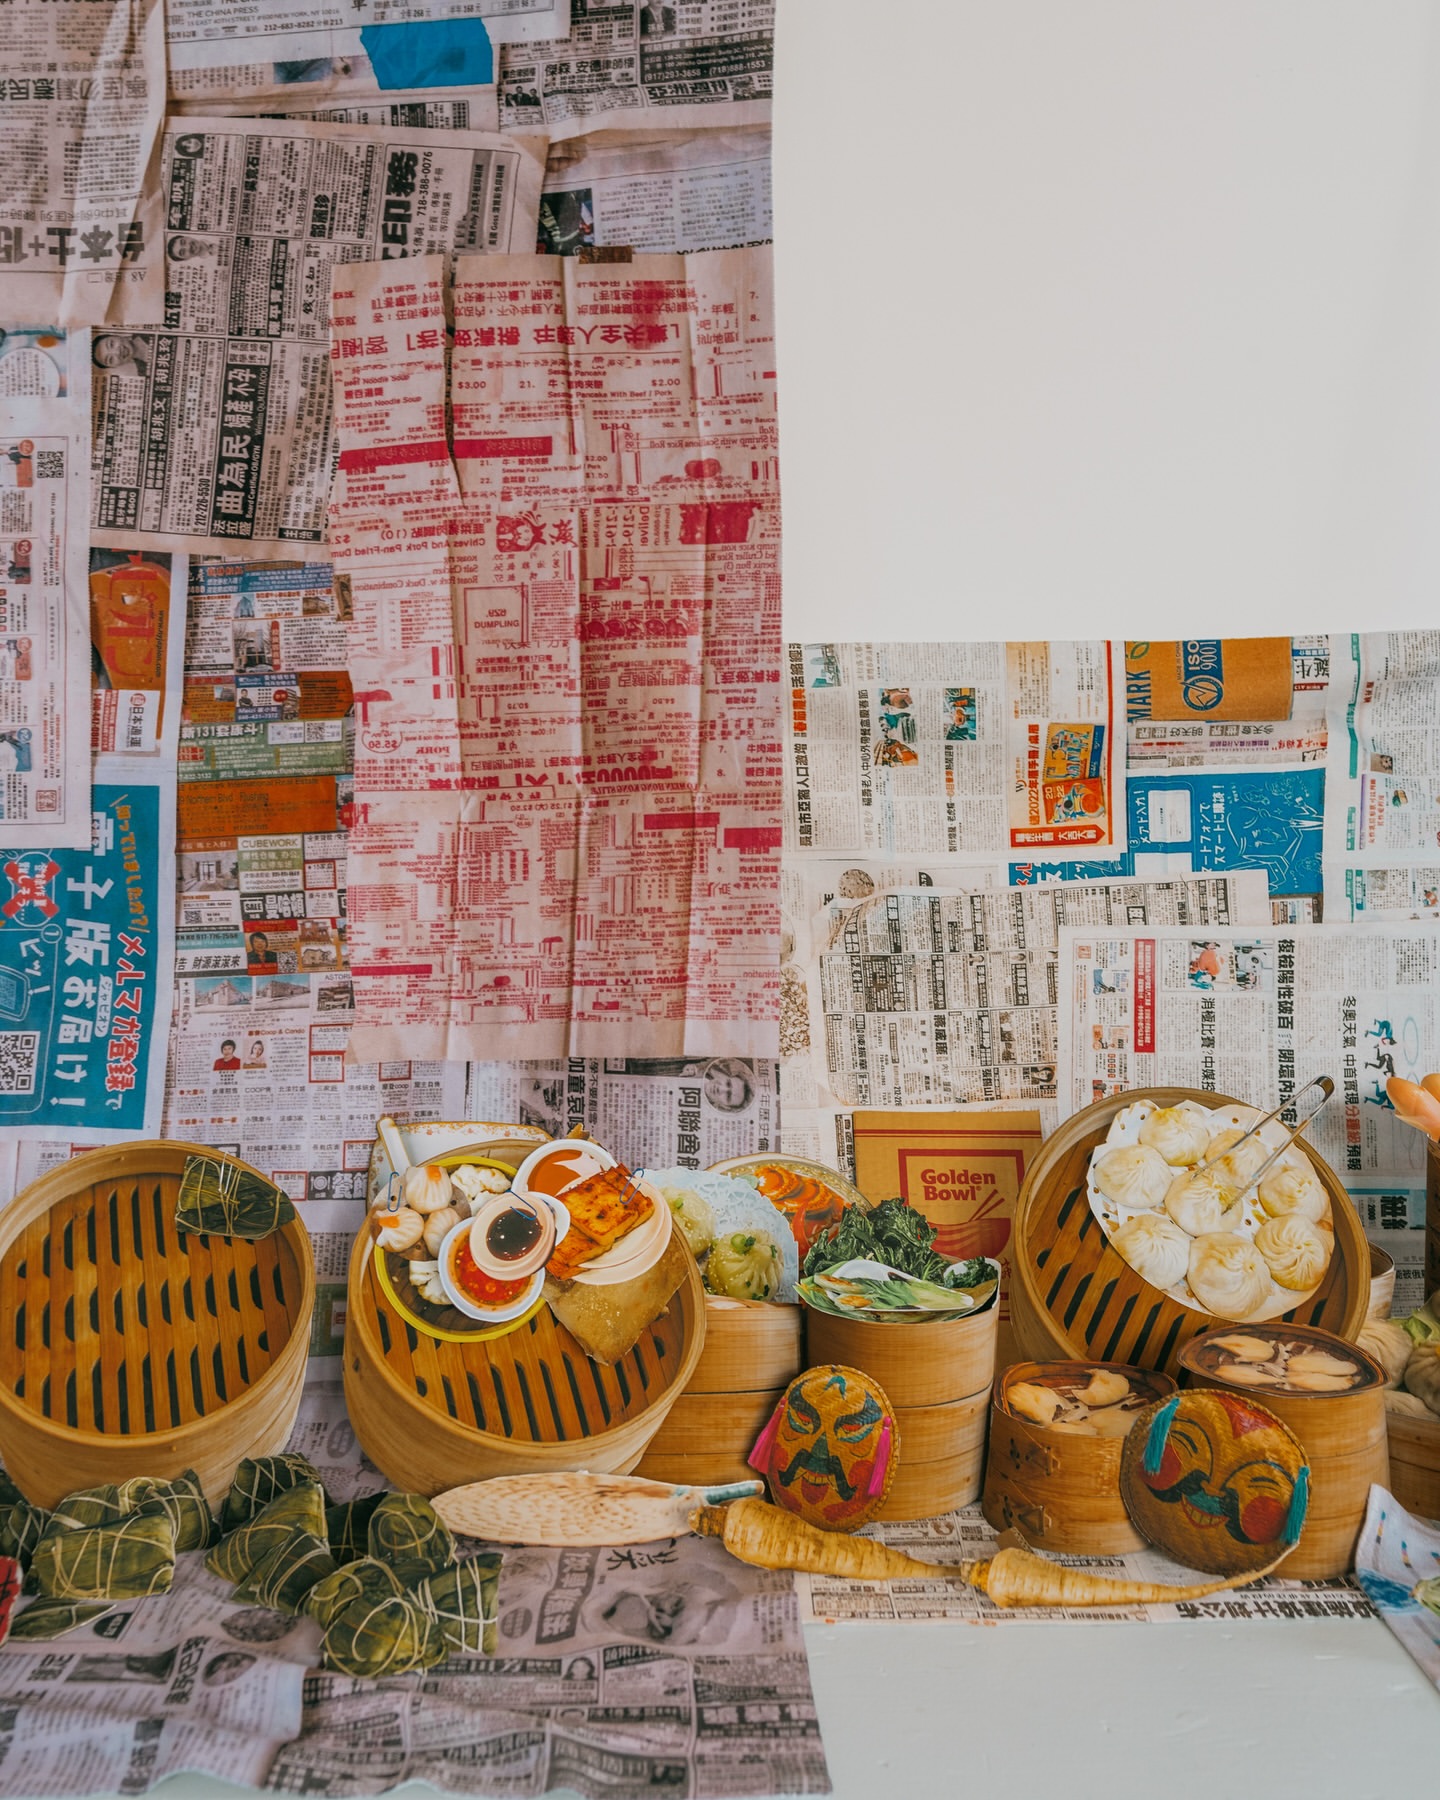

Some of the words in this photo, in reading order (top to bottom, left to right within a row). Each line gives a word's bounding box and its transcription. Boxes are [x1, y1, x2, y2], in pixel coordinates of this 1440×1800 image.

[205, 9, 230, 17] CHINA
[234, 6, 258, 14] PRESS
[416, 150, 433, 216] 718-388-0076
[130, 271, 146, 280] A8
[225, 366, 257, 396] 不孕
[457, 380, 486, 389] $3.00
[519, 380, 535, 388] 21.
[651, 378, 681, 387] $2.00
[610, 390, 621, 398] With
[654, 389, 672, 397] Pork
[223, 398, 254, 429] 婦產
[247, 471, 257, 499] Certified
[194, 477, 211, 526] 212-226-5530
[211, 518, 252, 536] 法拉盛
[474, 619, 519, 629] DUMPLING
[1187, 640, 1199, 670] ISO
[1199, 640, 1217, 669] 9001
[131, 705, 144, 748] 日本通運
[1134, 789, 1151, 843] メアド入力！
[241, 839, 297, 848] CUBEWORK
[245, 902, 262, 912] SALE
[102, 935, 139, 1109] メルマガ登録で
[920, 1168, 996, 1184] Golden
[922, 1185, 976, 1200] Bowl
